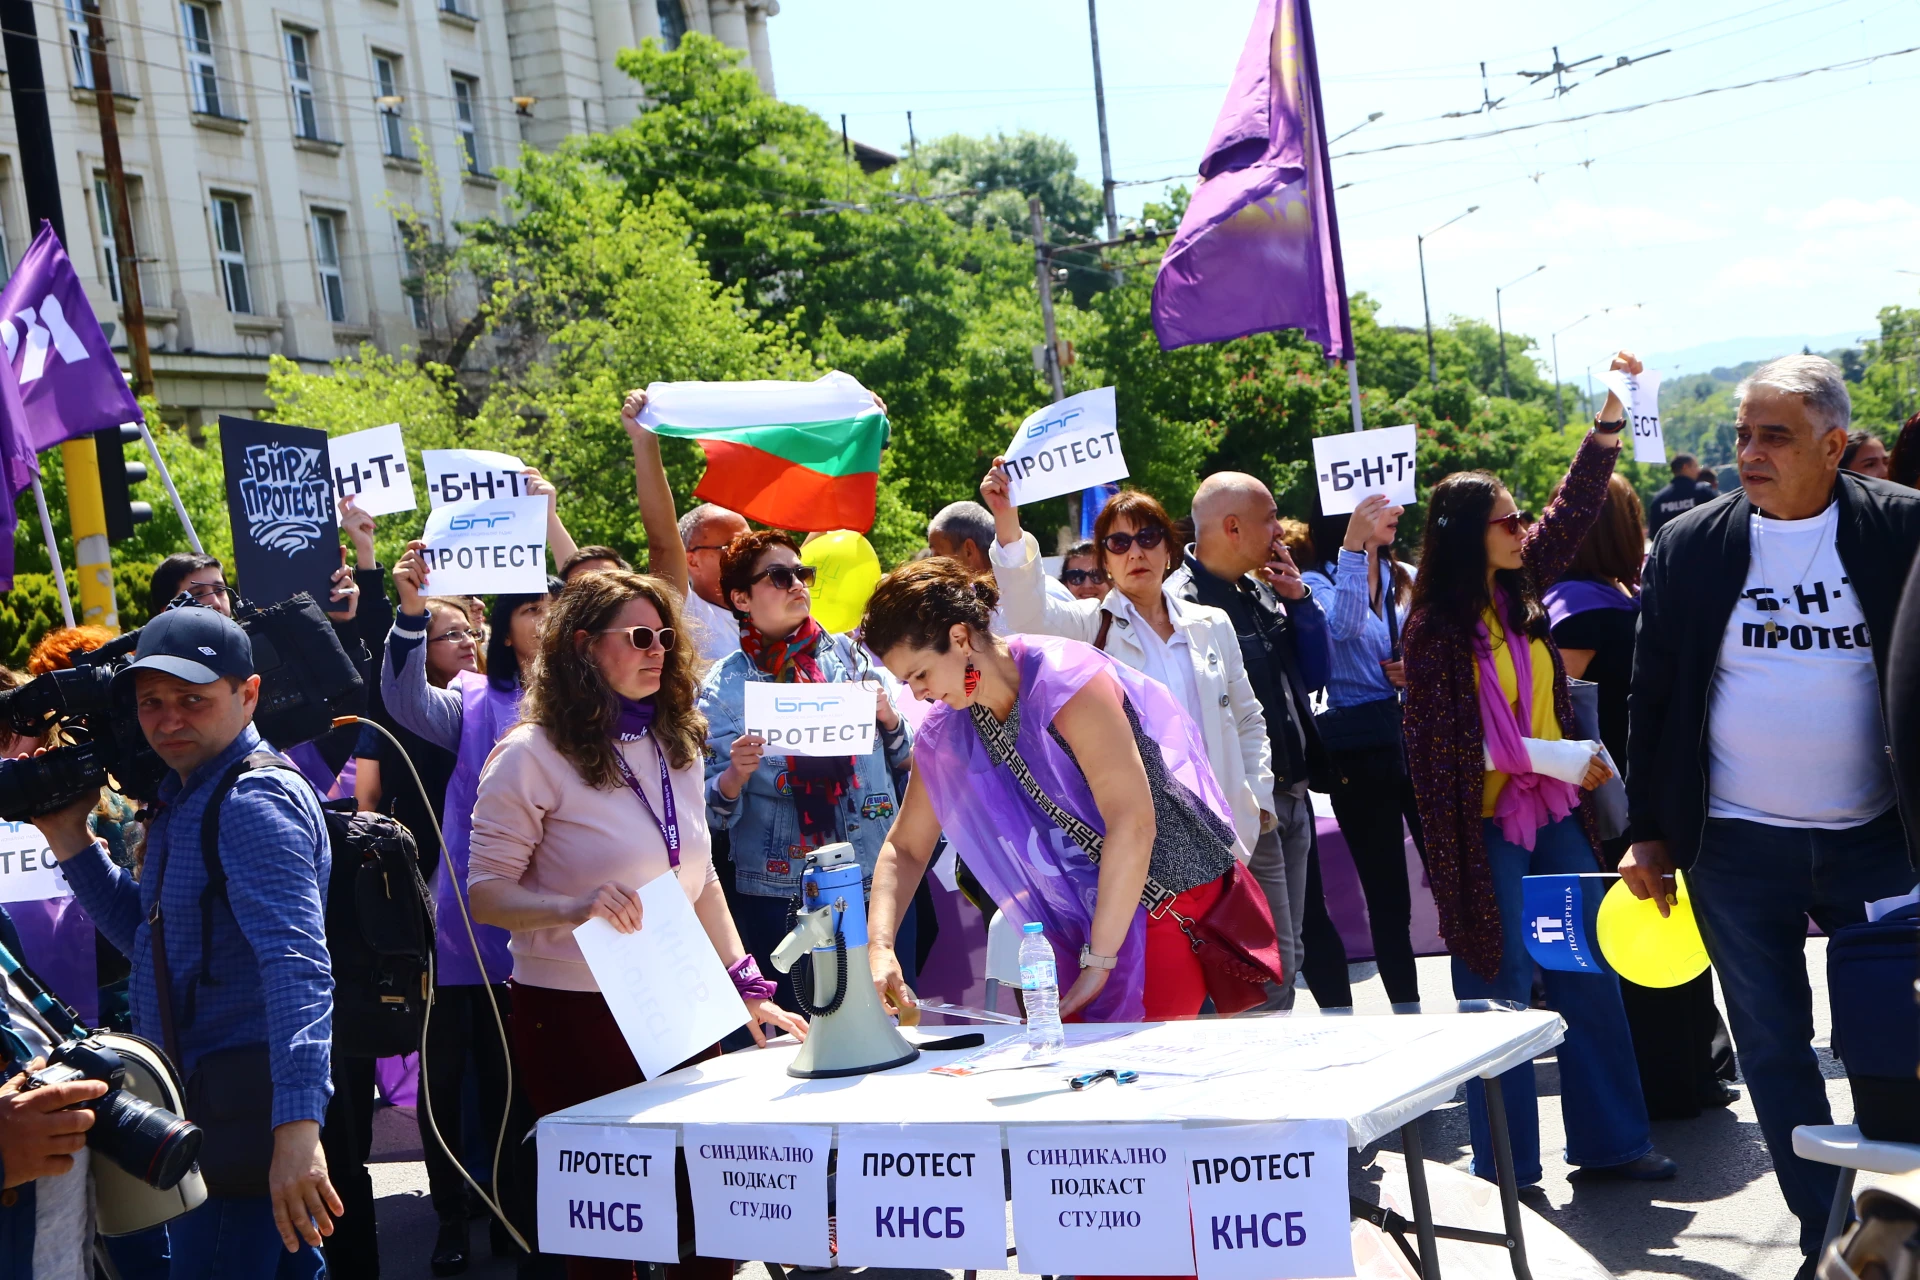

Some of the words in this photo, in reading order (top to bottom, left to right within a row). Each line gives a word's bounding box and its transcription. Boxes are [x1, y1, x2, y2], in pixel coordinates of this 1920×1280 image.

[245, 446, 303, 483] БНР
[1003, 432, 1115, 482] ПРОТЕСТ
[240, 479, 328, 523] ПРОТЕСТ
[419, 545, 543, 570] ПРОТЕСТ
[747, 723, 873, 746] ПРОТЕСТ
[668, 824, 678, 849] КНСБ
[1564, 886, 1579, 951] ПОДКРЕПА
[559, 1149, 652, 1177] ПРОТЕСТ
[699, 1144, 814, 1164] СИНДИКАЛНО
[862, 1152, 975, 1178] ПРОТЕСТ
[1027, 1147, 1167, 1168] СИНДИКАЛНО
[722, 1170, 797, 1190] ПОДКАСТ
[1192, 1151, 1315, 1185] ПРОТЕСТ
[1050, 1177, 1146, 1198] ПОДКАСТ
[569, 1199, 644, 1233] КНСБ
[729, 1200, 792, 1221] СТУДИО
[875, 1206, 965, 1239] КНСБ
[1058, 1210, 1141, 1231] СТУДИО
[1211, 1211, 1307, 1250] КНСБ
